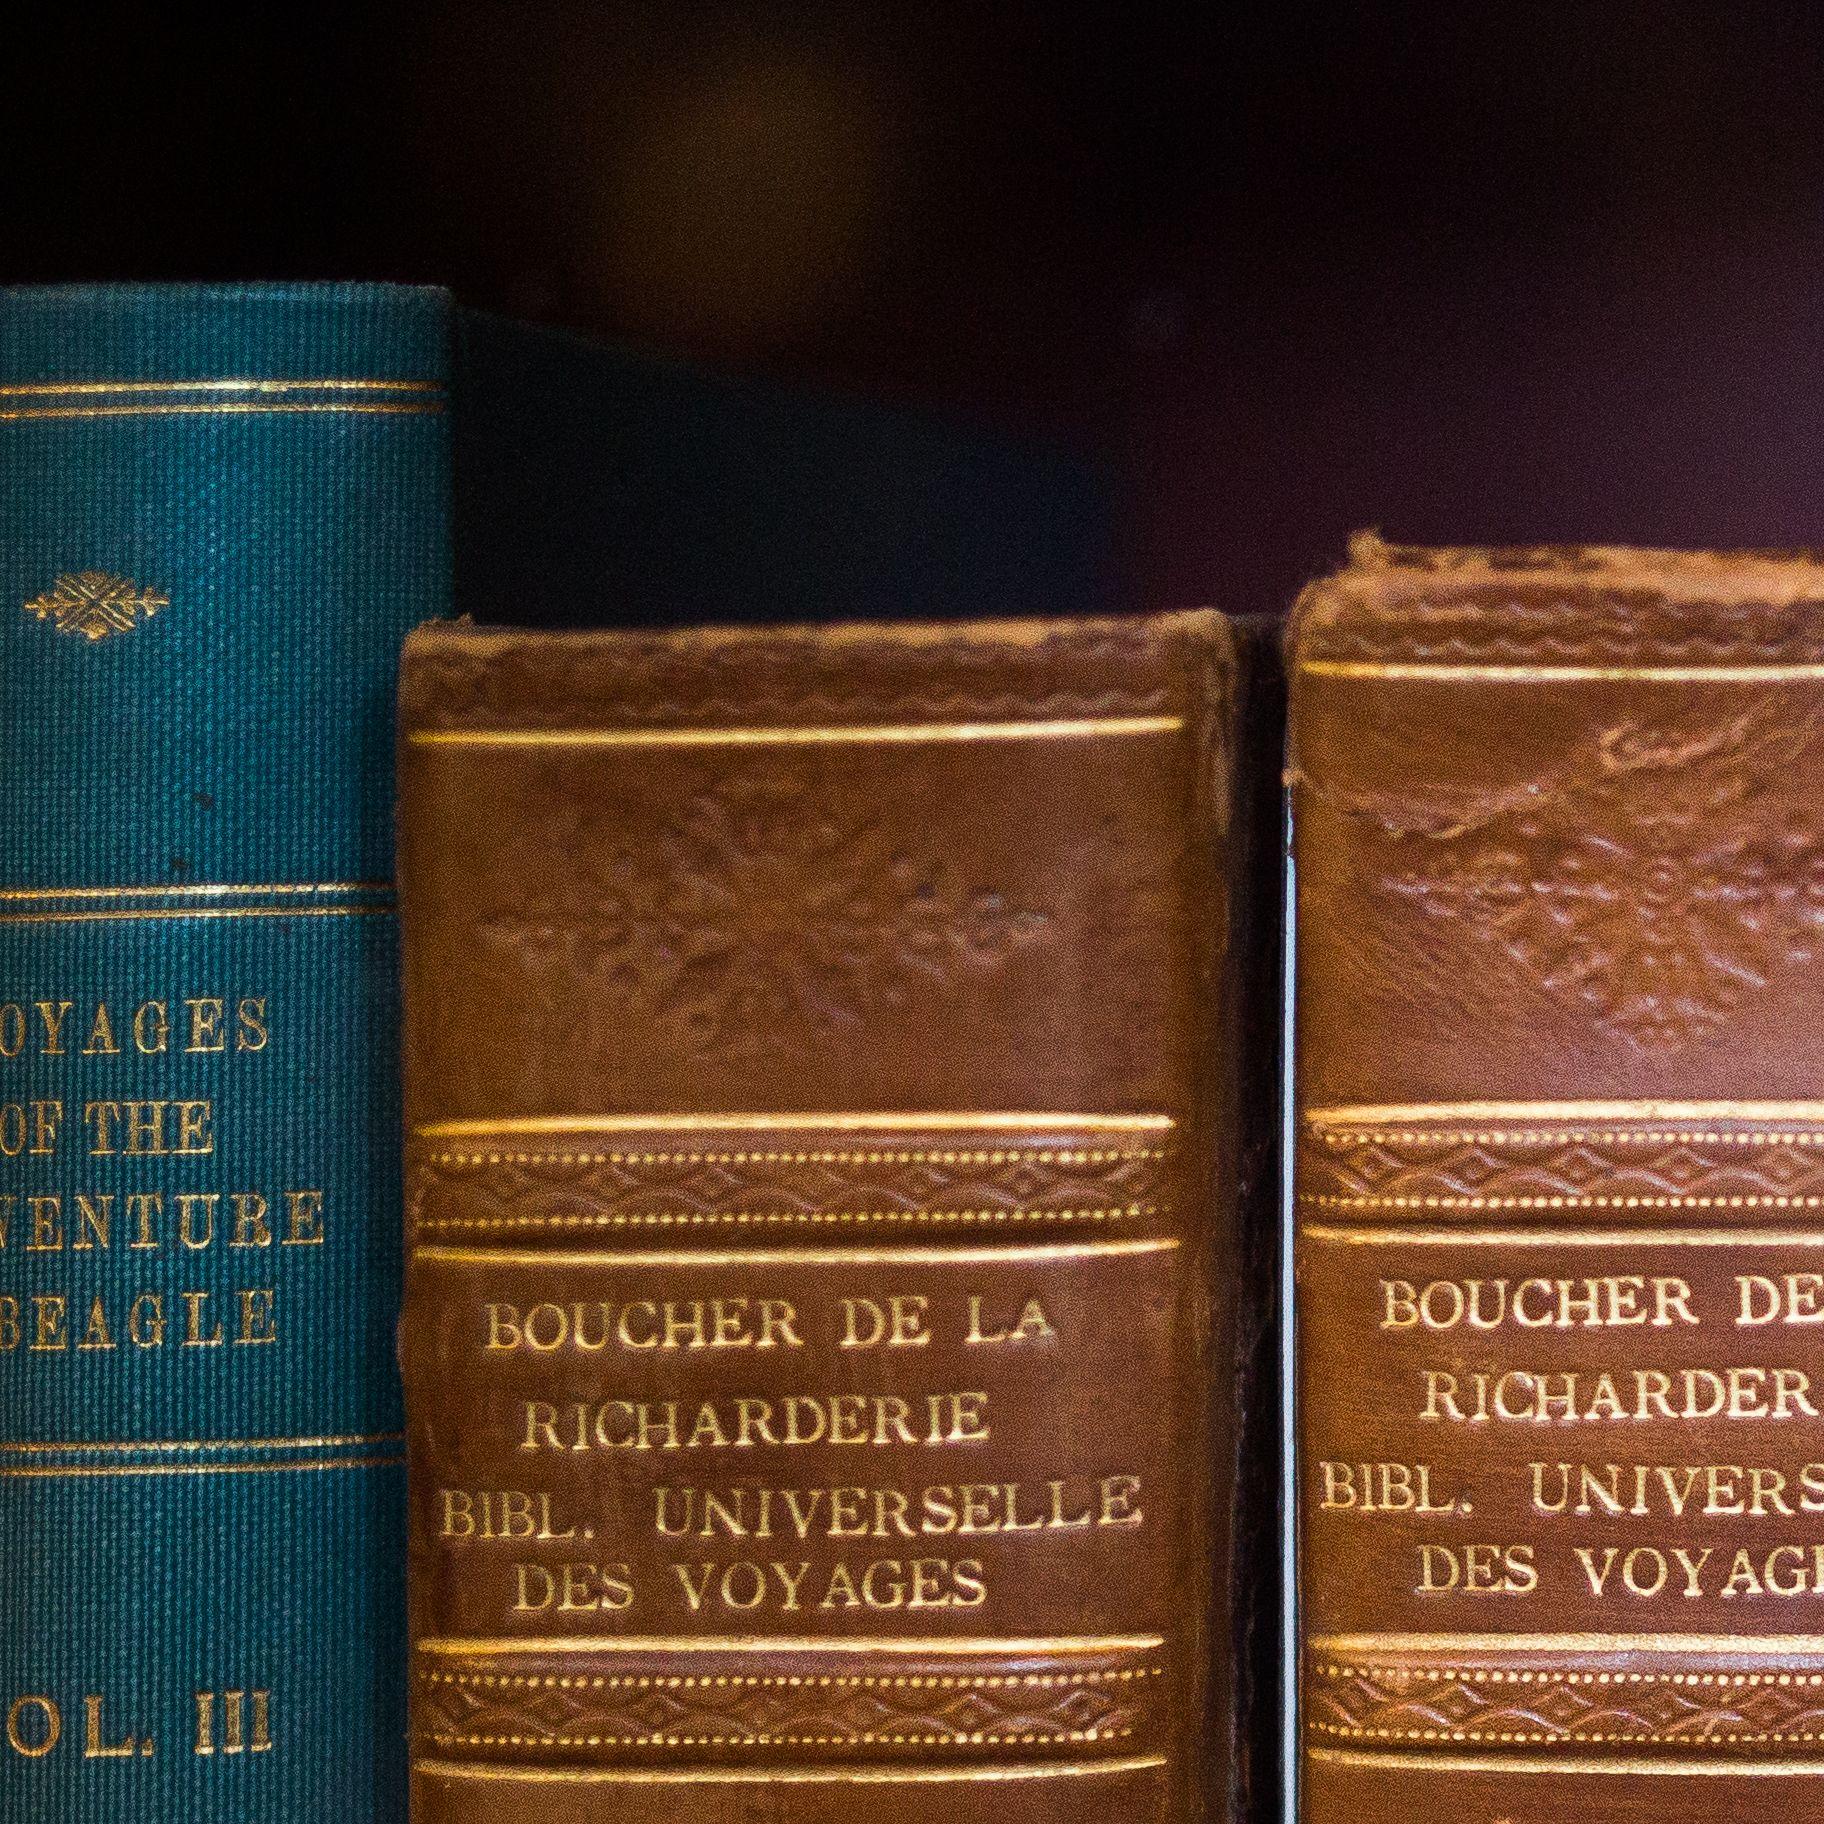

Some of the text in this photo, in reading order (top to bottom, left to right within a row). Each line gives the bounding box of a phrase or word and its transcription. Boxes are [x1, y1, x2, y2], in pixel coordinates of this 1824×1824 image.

[0, 1099, 213, 1156] OF THE
[485, 1295, 1056, 1353] BOUCHER DE LA
[1380, 1276, 1700, 1330] BOUCHER
[521, 1390, 990, 1452] RICHARDERIE
[440, 1473, 1145, 1541] BIBL. UNIVERSELLE
[1319, 1461, 1474, 1515] BIBL.
[512, 1558, 988, 1613] DES VOYAGES
[1415, 1545, 1537, 1597] DES
[6, 1688, 272, 1757] OL. III
